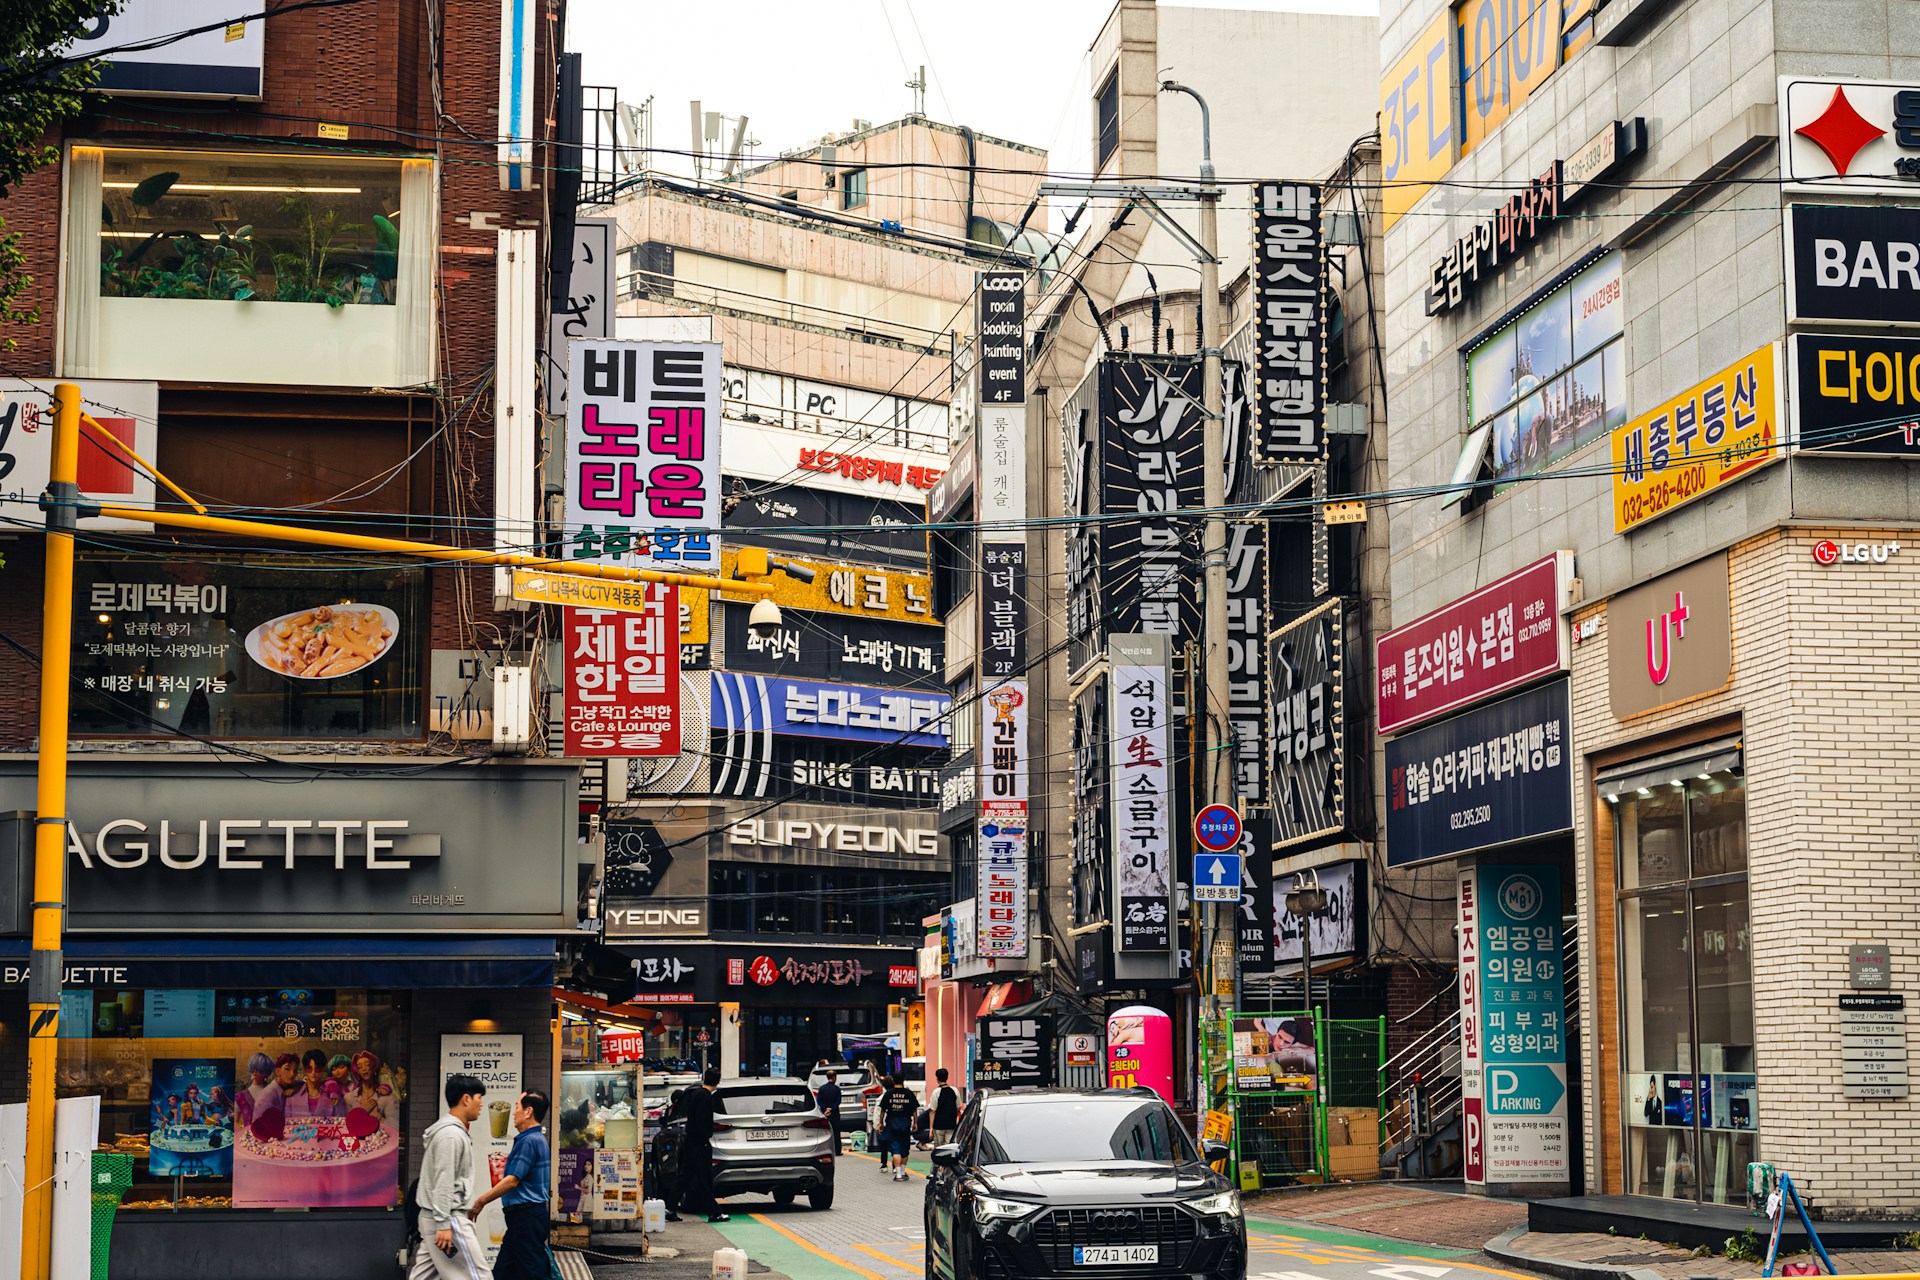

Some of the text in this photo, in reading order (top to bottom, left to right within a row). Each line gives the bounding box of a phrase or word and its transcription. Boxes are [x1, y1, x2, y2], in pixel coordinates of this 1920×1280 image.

[982, 277, 1023, 292] LOOP
[990, 302, 1016, 313] room
[983, 321, 1023, 338] booking
[1263, 185, 1319, 453] 바운스뮤직뱅크
[983, 343, 1022, 361] hunting
[583, 349, 706, 403] 비트
[989, 368, 1017, 380] event
[806, 392, 837, 416] PC
[994, 390, 1012, 401] 4F
[579, 404, 706, 461] 노래
[1622, 364, 1758, 485] 세종부동산
[993, 417, 1009, 466] 룸술집
[797, 447, 905, 486] 보드게임카페
[905, 465, 948, 489] 레드
[579, 461, 706, 519] 타운
[993, 474, 1009, 507] 캐슬
[1622, 462, 1706, 525] 032-526-4200
[985, 550, 1022, 564] 룸술집
[990, 566, 1014, 596] 더
[89, 582, 227, 614] 로제떡볶이
[551, 583, 642, 607] 다목적 CCTV 작동중
[124, 621, 191, 637] 달콤한 향기
[989, 599, 1019, 658] 블랙
[1403, 602, 1515, 701] 톤즈의원 본점
[995, 661, 1014, 673] 2F
[101, 675, 227, 694] 매장 내 취식 가능
[570, 705, 672, 720] 그냥 작고 소박한
[570, 720, 672, 734] Cafe & Lounge
[580, 733, 663, 749] 5층
[992, 721, 1017, 797] 간빠이
[793, 760, 853, 788] SING
[1405, 760, 1431, 806] 한솔
[1201, 823, 1236, 832] 주정차금지
[68, 819, 411, 870] AGUETTE
[410, 895, 466, 907] 파리바게뜨
[1195, 887, 1239, 899] 일방통행
[605, 908, 700, 927] YEONG
[989, 873, 1017, 940] 노래타운
[1486, 925, 1555, 951] 엠공일
[4, 967, 128, 983] BAUETTE
[1461, 879, 1478, 1059] 톤즈의원
[1487, 957, 1534, 983] 의원
[1488, 1010, 1559, 1031] 피부과
[989, 1019, 1041, 1090] 바운스
[1489, 1033, 1560, 1054] 성형외과
[463, 1060, 501, 1069] BEST
[1110, 1060, 1140, 1072] 드림타이
[446, 1072, 518, 1082] BERAGE
[1491, 1069, 1542, 1111] PARKING
[766, 1129, 785, 1138] 5803
[1123, 1247, 1155, 1262] 1402
